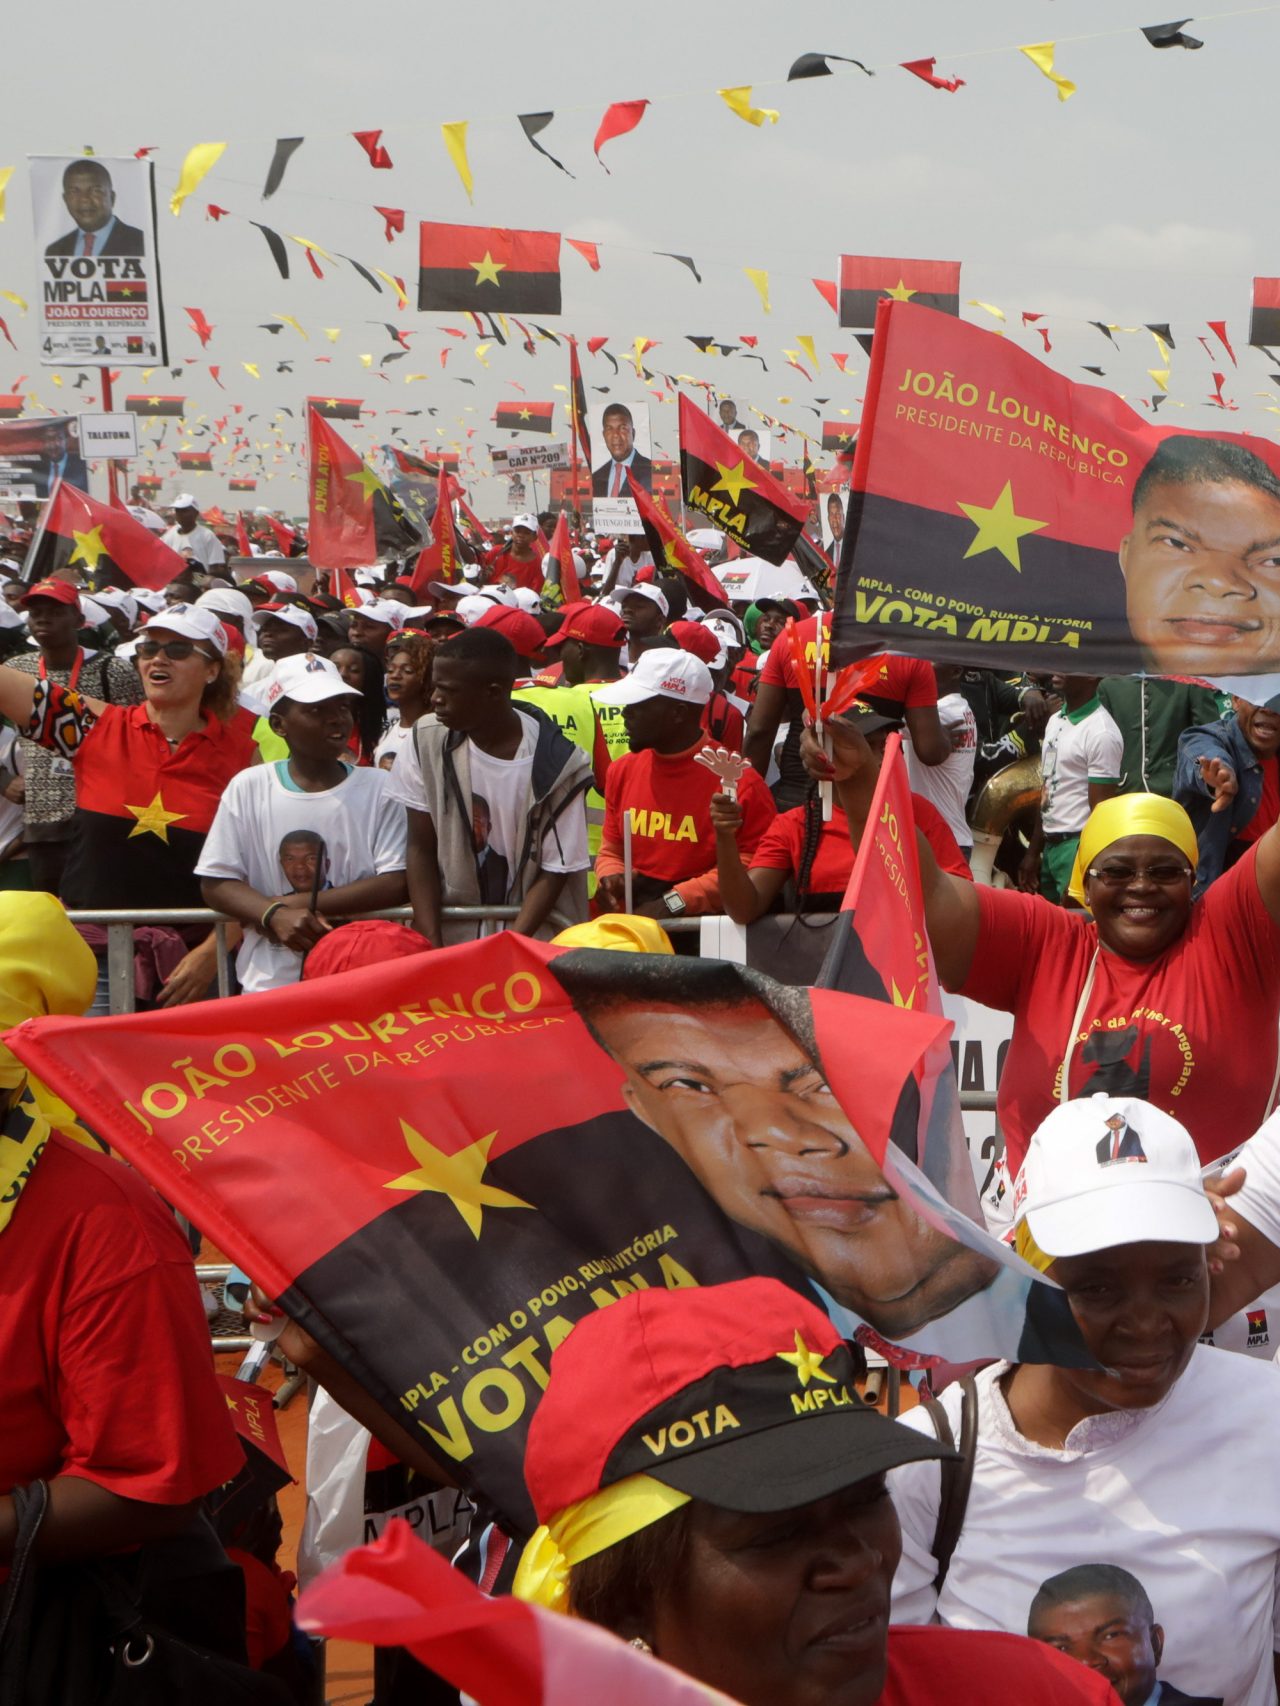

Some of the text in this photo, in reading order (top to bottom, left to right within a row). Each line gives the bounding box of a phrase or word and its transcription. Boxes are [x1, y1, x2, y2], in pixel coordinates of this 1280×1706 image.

[44, 258, 146, 279] VOTA
[43, 281, 106, 303] MPLA
[47, 305, 147, 319] JOÃO LOURENÇO
[43, 336, 53, 354] 4
[87, 431, 131, 440] TALATONA
[898, 369, 1129, 468] JOÃO LOURENÇO
[508, 457, 529, 468] CAP
[895, 403, 1126, 486] PRESIDENTE DA REPÚBLICA
[688, 484, 750, 536] MPLA
[855, 590, 958, 636] VOTA
[857, 576, 894, 594] MPLA
[904, 587, 934, 605] COM
[935, 596, 947, 608] O
[948, 599, 986, 619] POVO,
[989, 609, 1030, 622] RUMO
[1043, 617, 1093, 631] VITÓRIA
[660, 681, 687, 694] MPLA
[629, 807, 699, 844] MPLA
[124, 970, 543, 1136] JOÃO LOURENÇO
[1107, 1016, 1127, 1029] da
[1168, 1023, 1196, 1097] Angolana
[172, 1015, 566, 1172] PRESIDENTE DA REPÚBLICA
[461, 1322, 513, 1366] COM
[509, 1310, 528, 1330] O
[526, 1275, 587, 1318] POVO,
[615, 1224, 679, 1270] VITÓRIA
[1246, 1332, 1270, 1346] MPLA
[243, 1395, 266, 1442] MPLA
[790, 1384, 855, 1415] MPLA
[641, 1403, 742, 1457] VOTA
